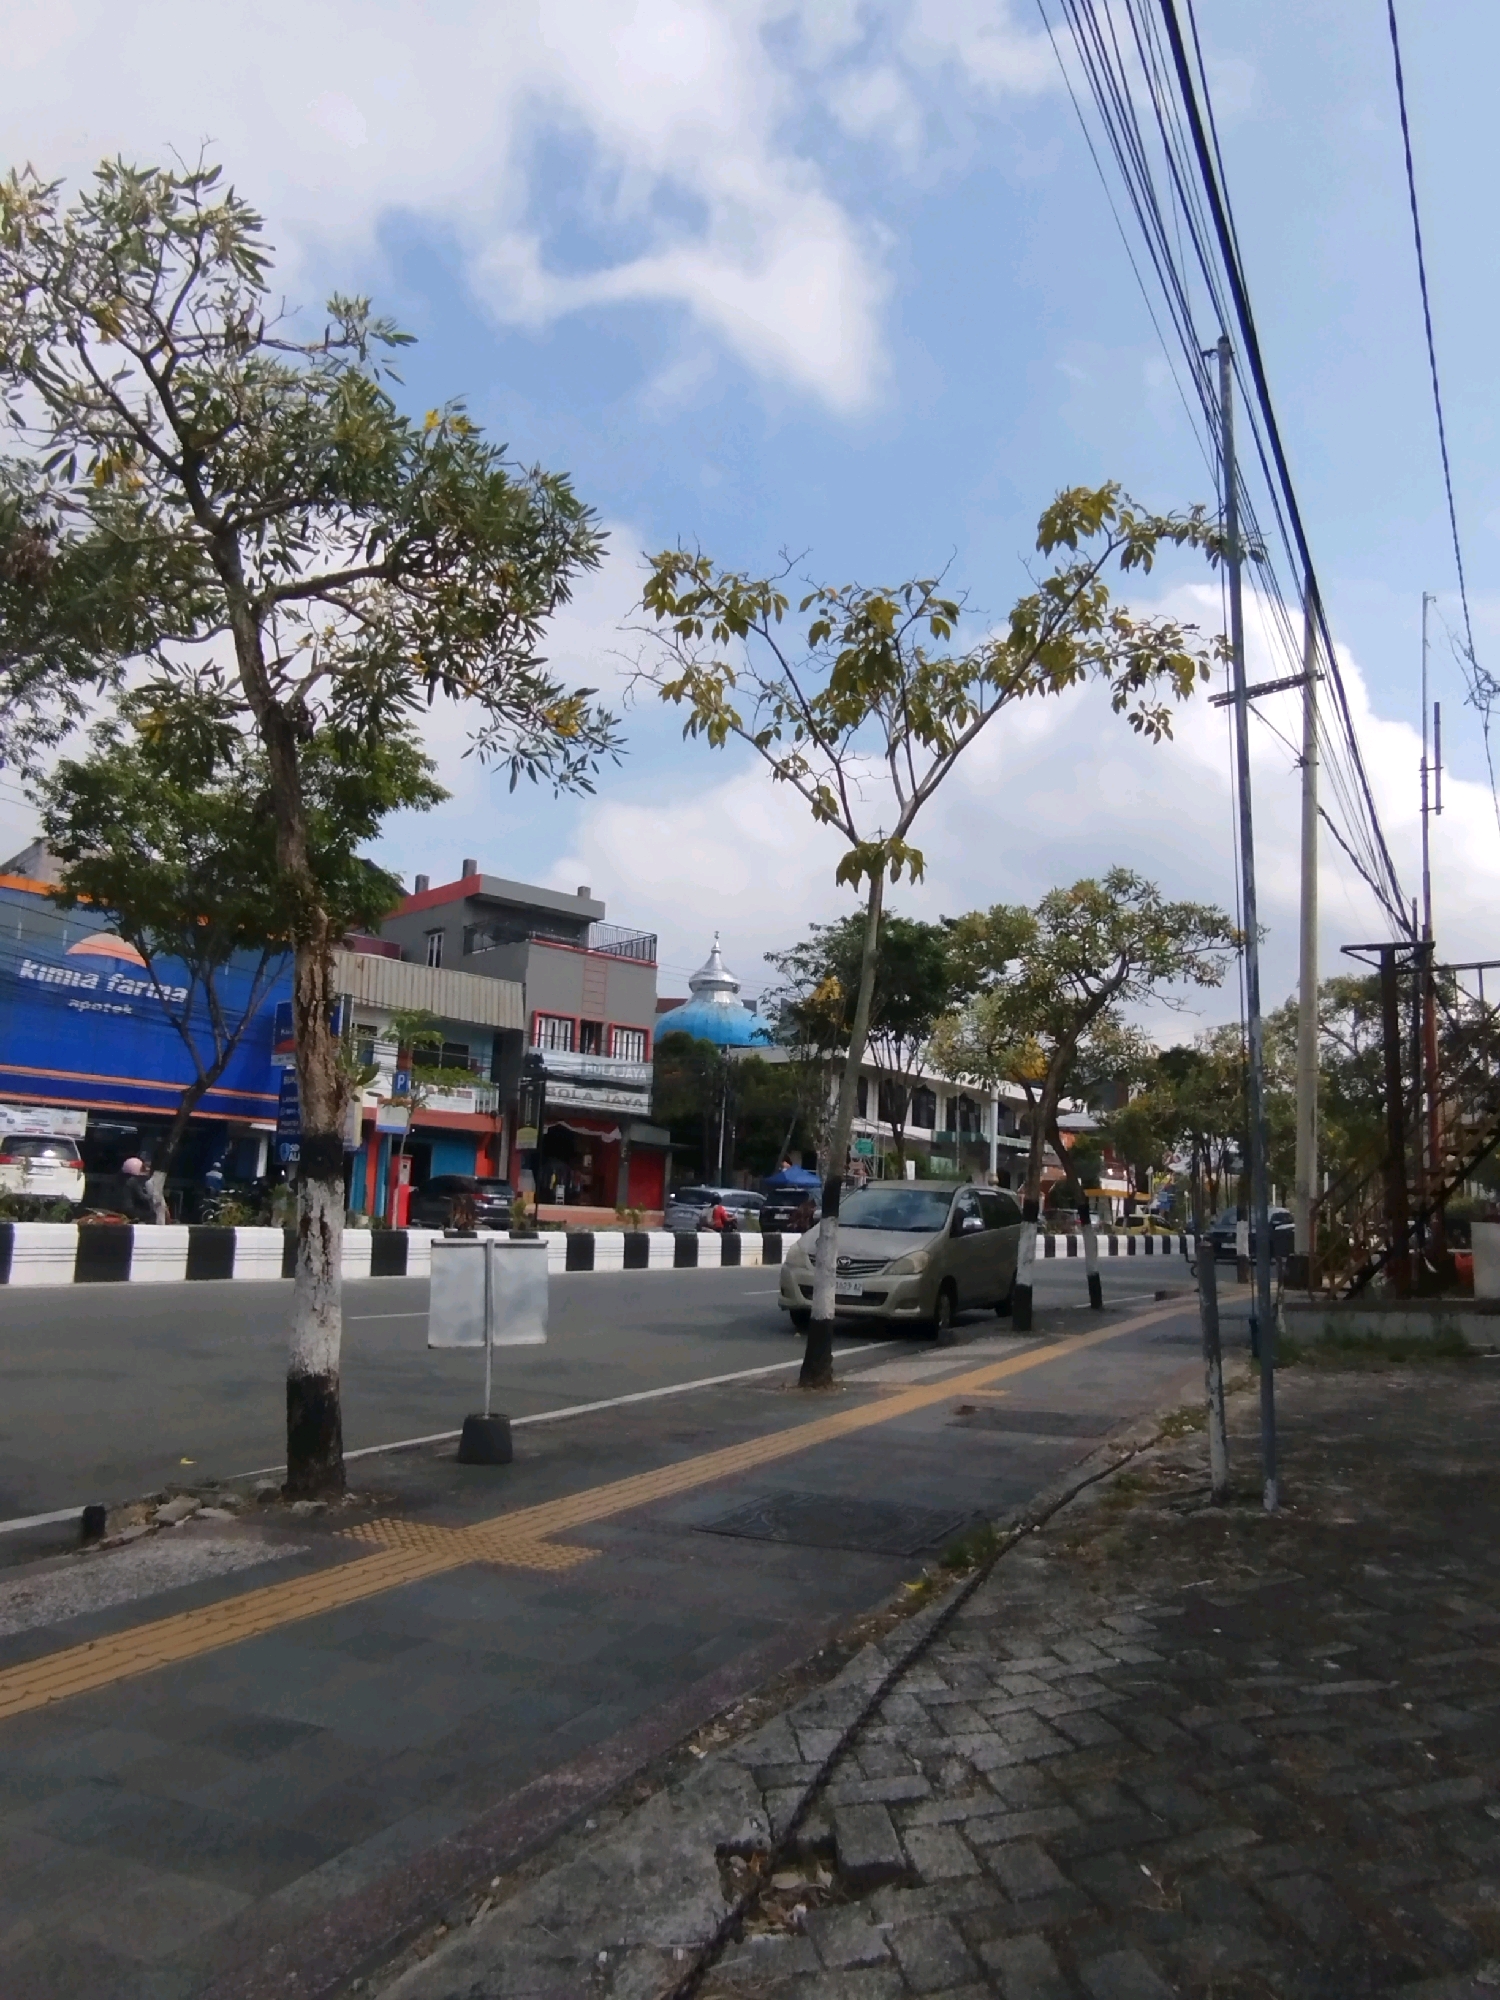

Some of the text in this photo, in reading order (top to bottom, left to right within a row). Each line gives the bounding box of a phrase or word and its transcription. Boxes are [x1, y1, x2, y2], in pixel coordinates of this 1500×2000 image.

[19, 960, 189, 1003] kimia farma
[67, 998, 133, 1014] apotek
[397, 1074, 405, 1089] P
[545, 1087, 643, 1108] BOLA JAYA
